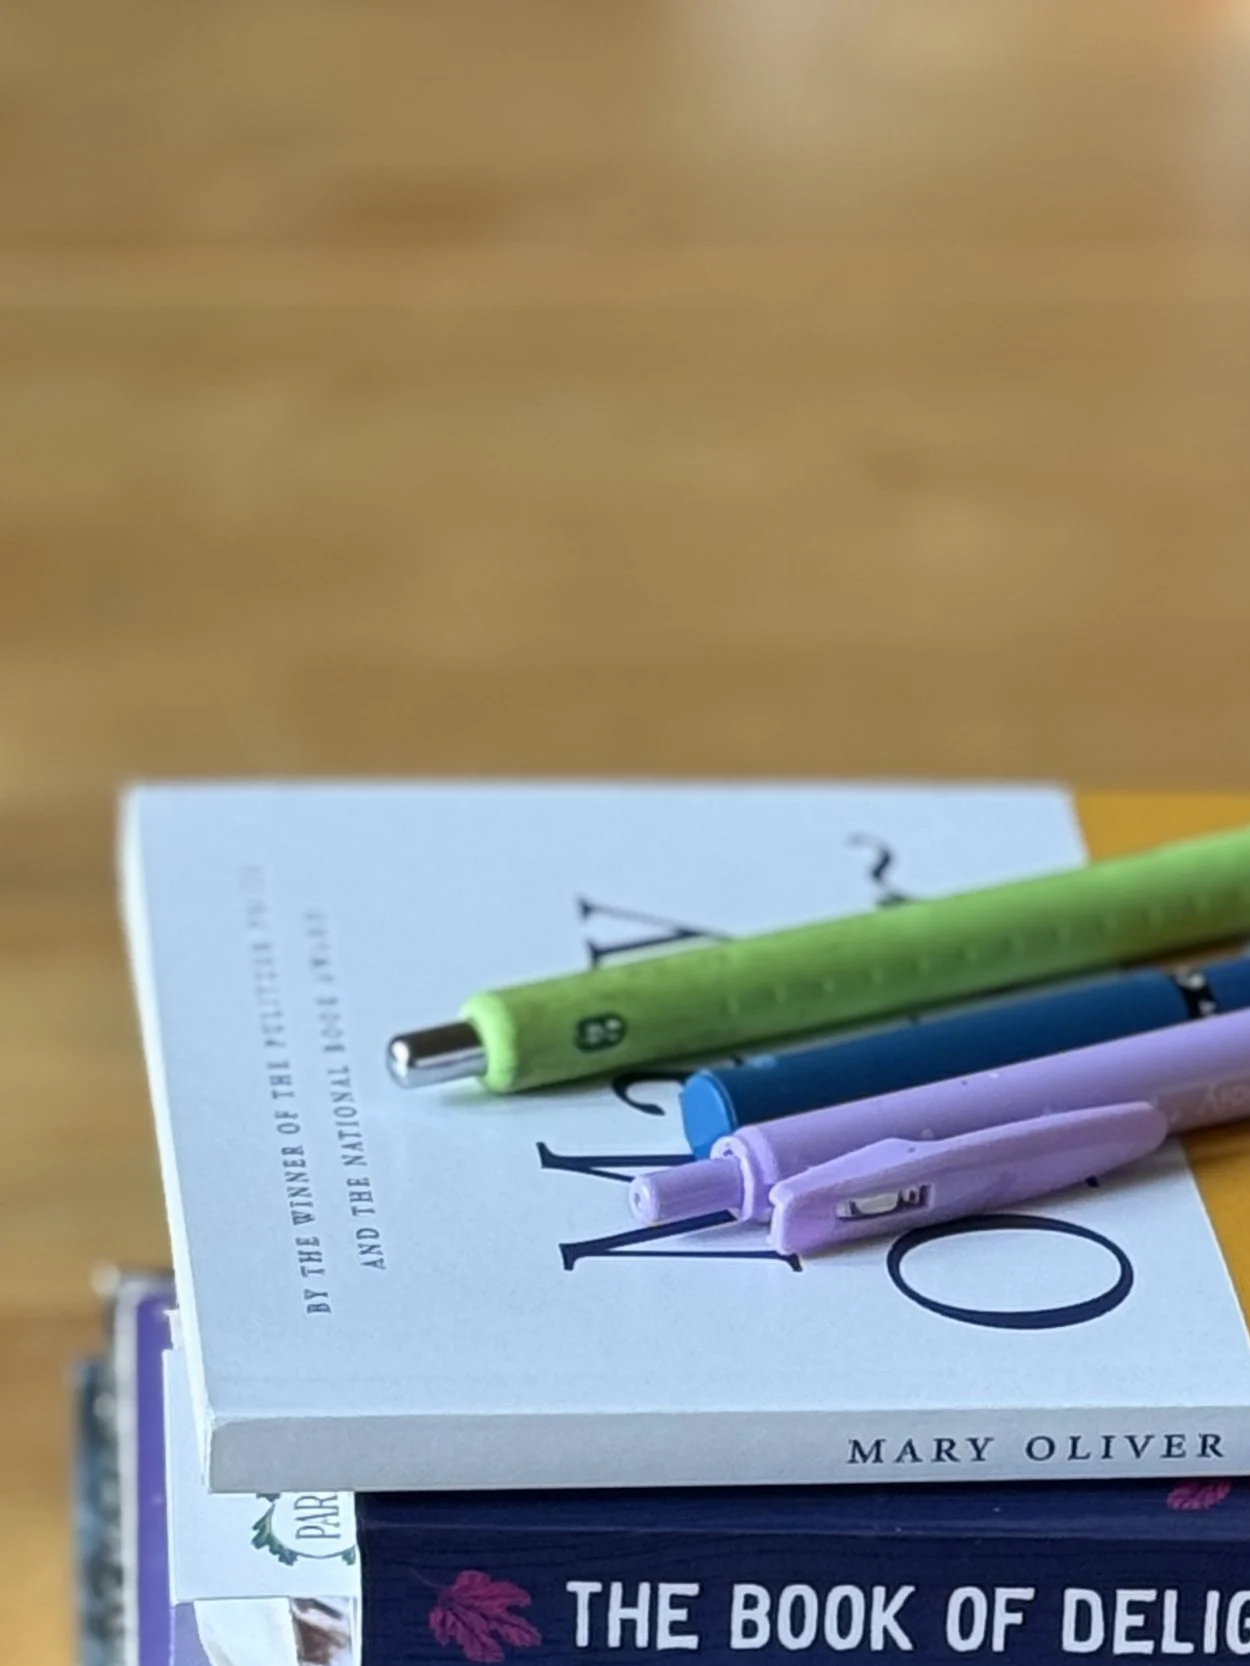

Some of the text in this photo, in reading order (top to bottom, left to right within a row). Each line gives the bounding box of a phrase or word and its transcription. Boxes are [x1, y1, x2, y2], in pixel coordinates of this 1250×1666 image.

[265, 1060, 297, 1100] THE
[274, 1109, 302, 1135] OF
[327, 1064, 367, 1167] NATIONAL
[281, 1145, 316, 1226] WINNER
[347, 1176, 377, 1217] THE
[294, 1236, 326, 1278] THE
[356, 1227, 387, 1272] AND
[304, 1289, 332, 1315] BY
[847, 1432, 1228, 1465] MARY OLIVER
[566, 1581, 699, 1649] THE
[730, 1584, 914, 1652] BOOK
[945, 1586, 1035, 1652] OF
